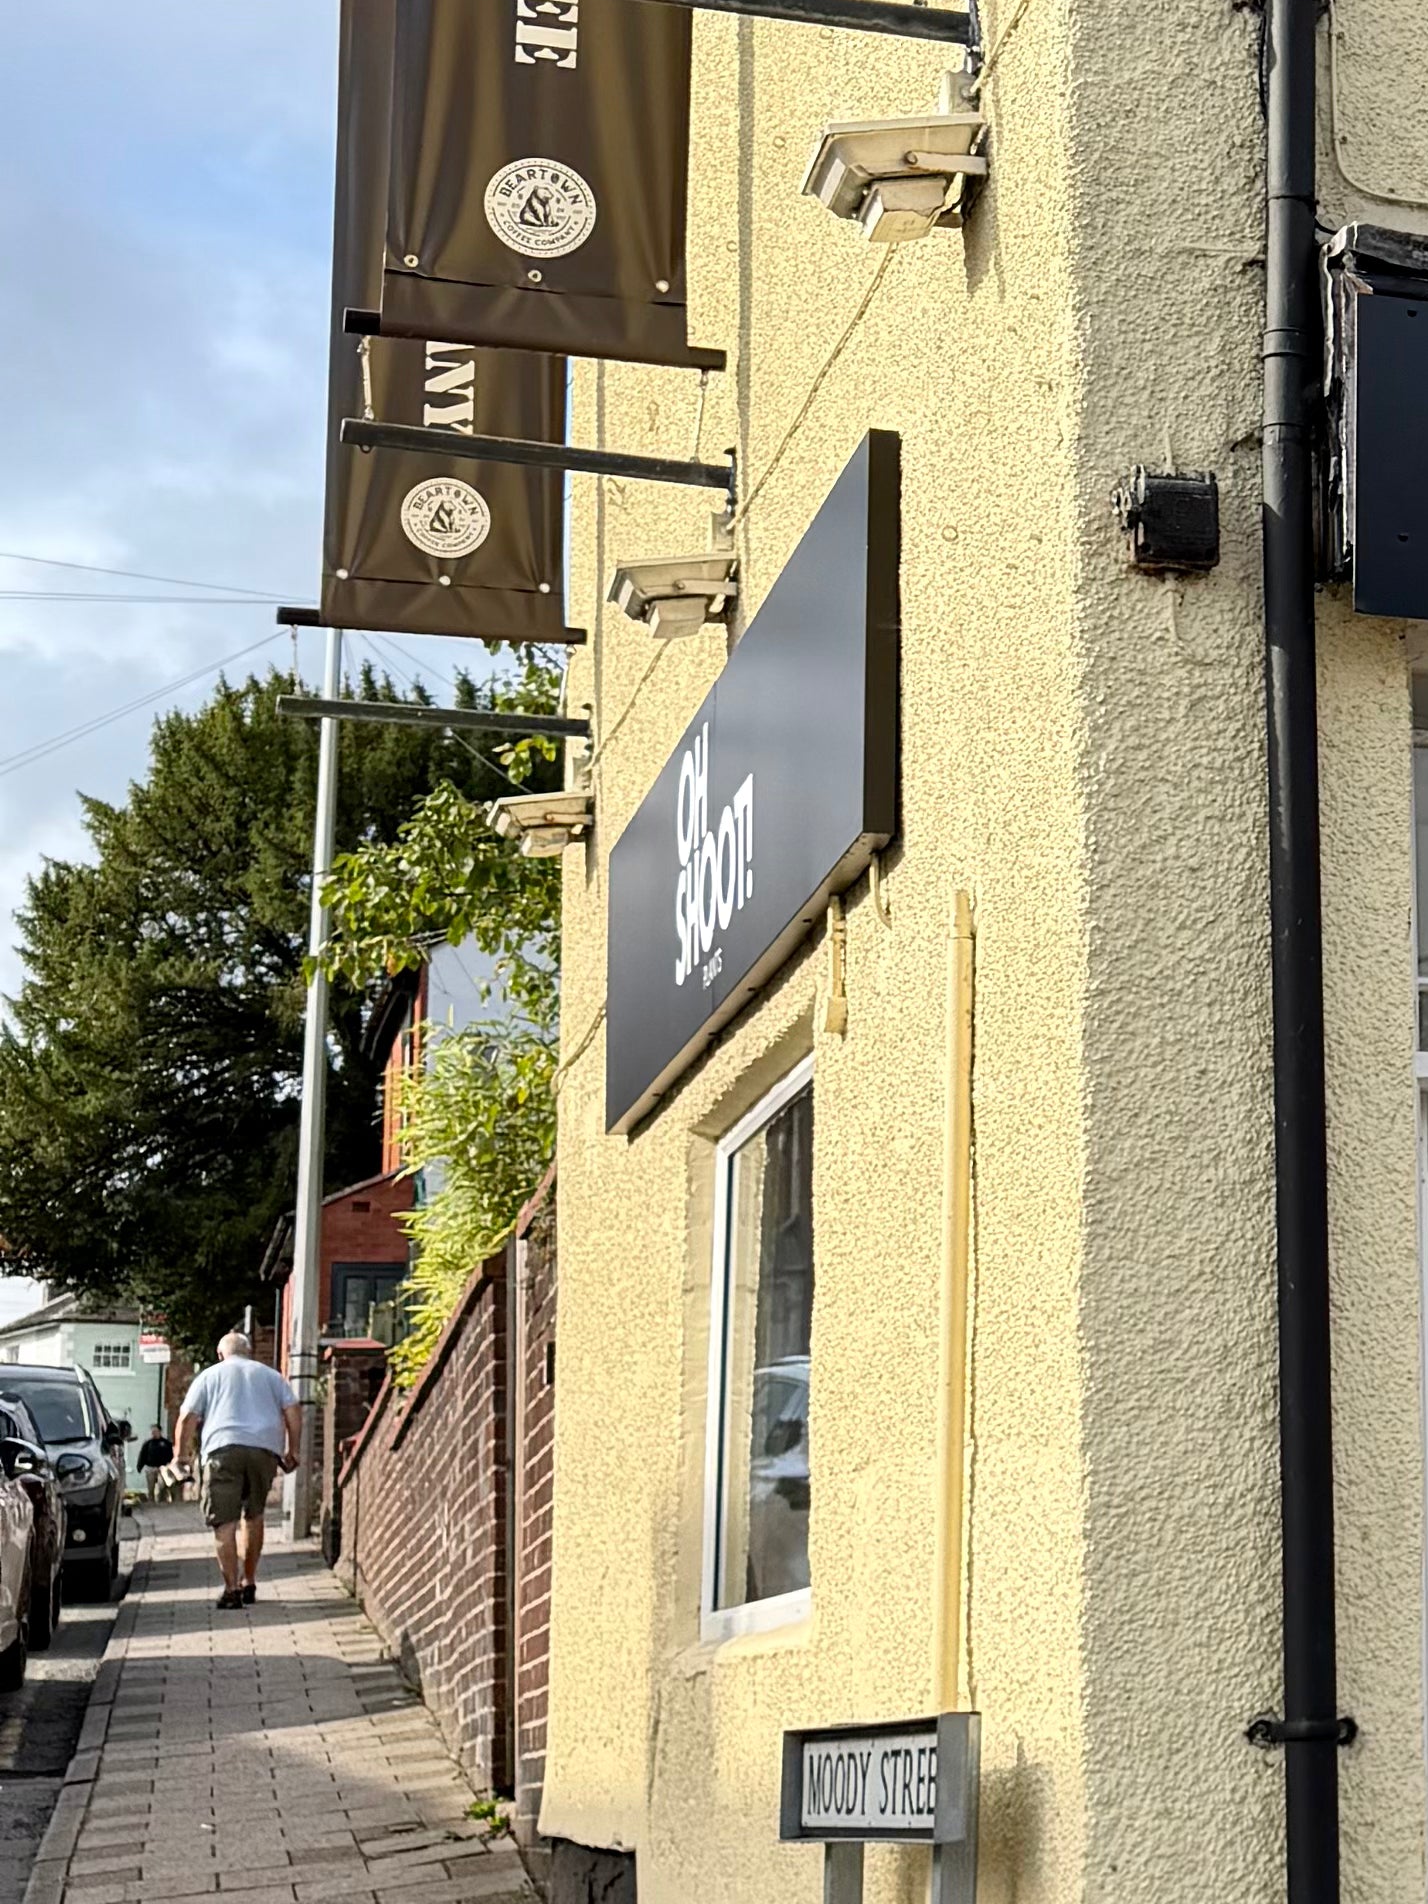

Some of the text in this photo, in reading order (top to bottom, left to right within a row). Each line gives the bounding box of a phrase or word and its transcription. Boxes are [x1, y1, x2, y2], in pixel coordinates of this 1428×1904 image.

[499, 168, 583, 205] BEARTOWN
[677, 721, 709, 867] OH
[675, 773, 753, 986] SHOOT!
[807, 1747, 937, 1815] MOODY STREE
